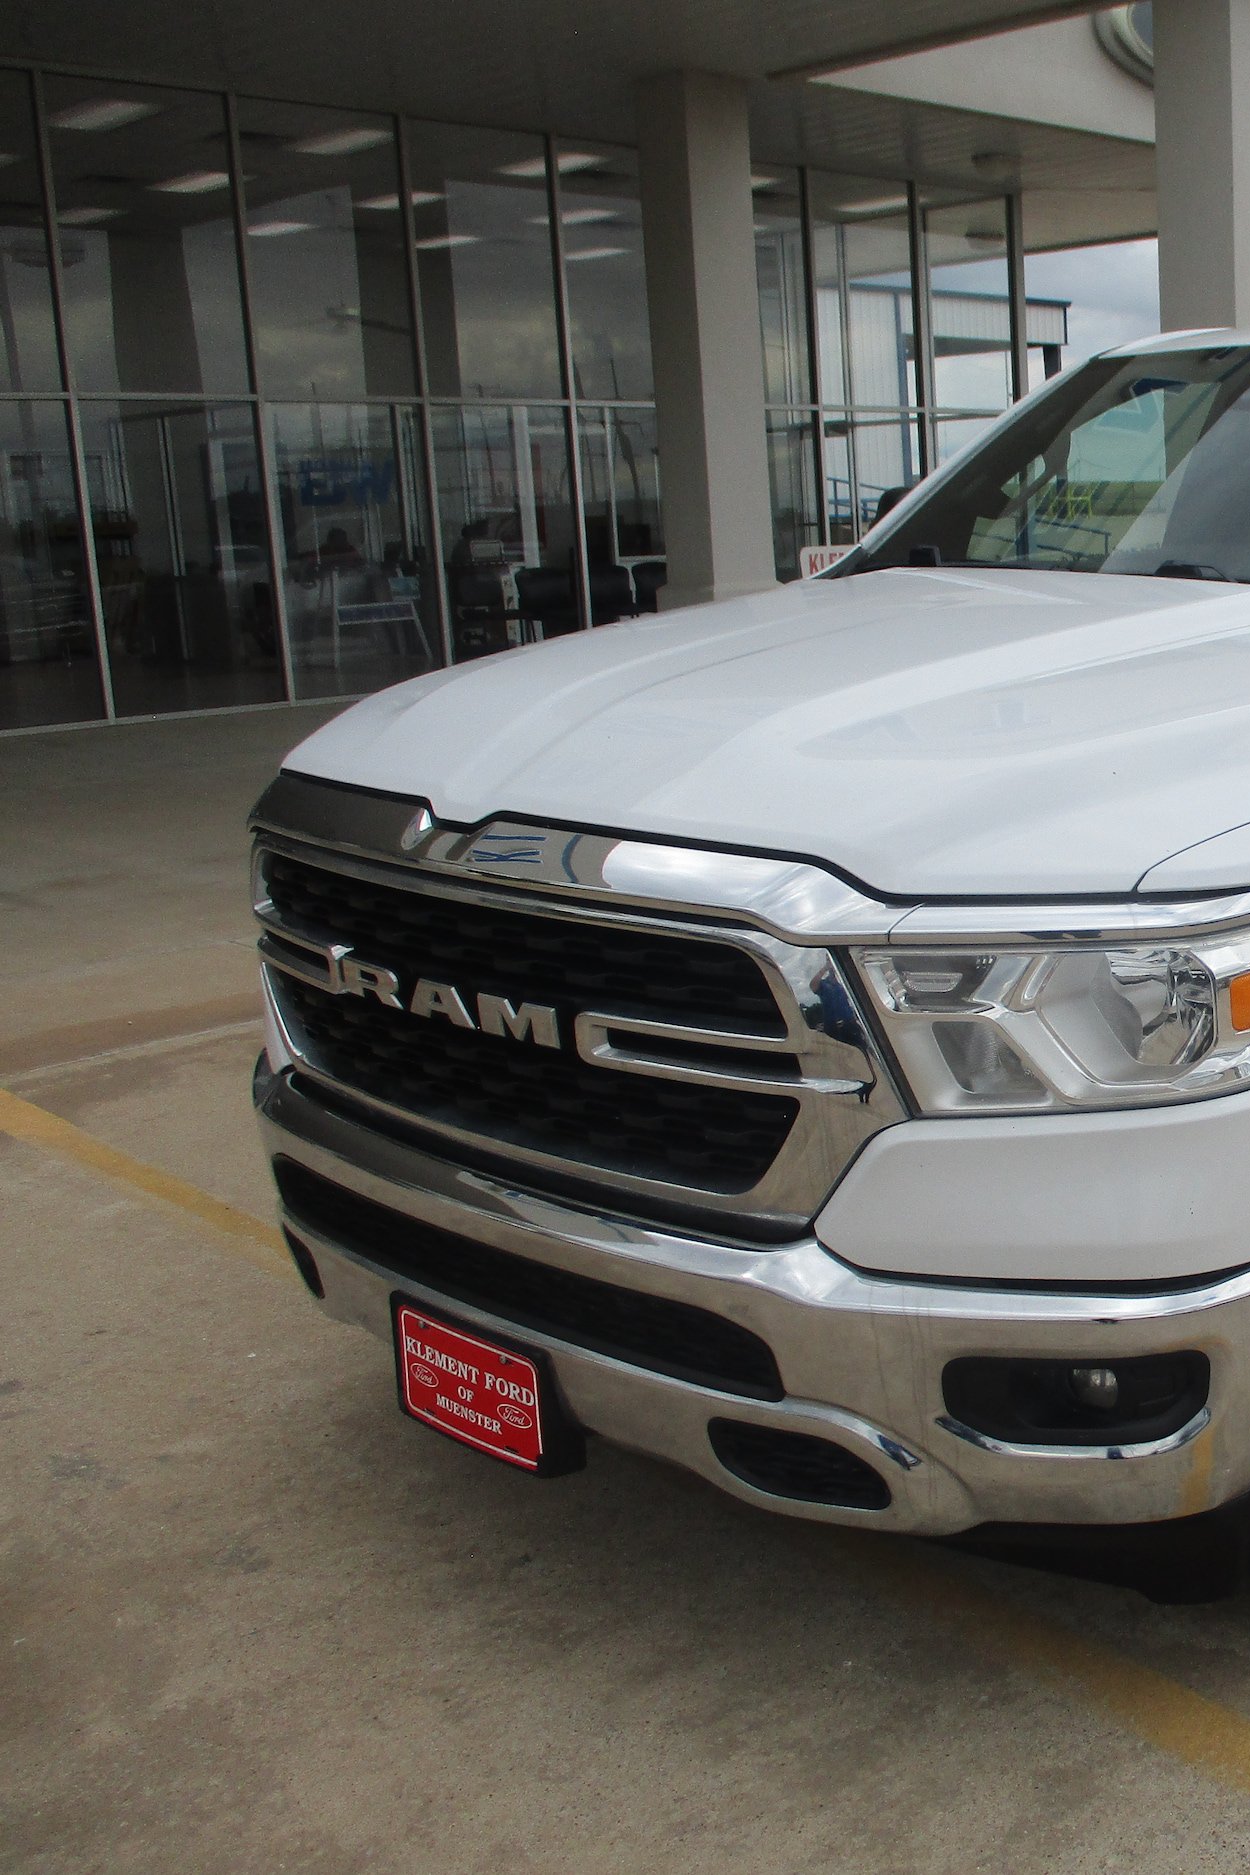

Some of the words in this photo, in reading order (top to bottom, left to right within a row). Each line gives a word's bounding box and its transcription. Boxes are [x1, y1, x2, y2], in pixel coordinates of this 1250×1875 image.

[341, 956, 561, 1050] RAM
[405, 1335, 480, 1385] KLEMENT
[483, 1371, 536, 1407] FORD
[457, 1385, 475, 1403] OF
[435, 1392, 503, 1435] MUENSTER
